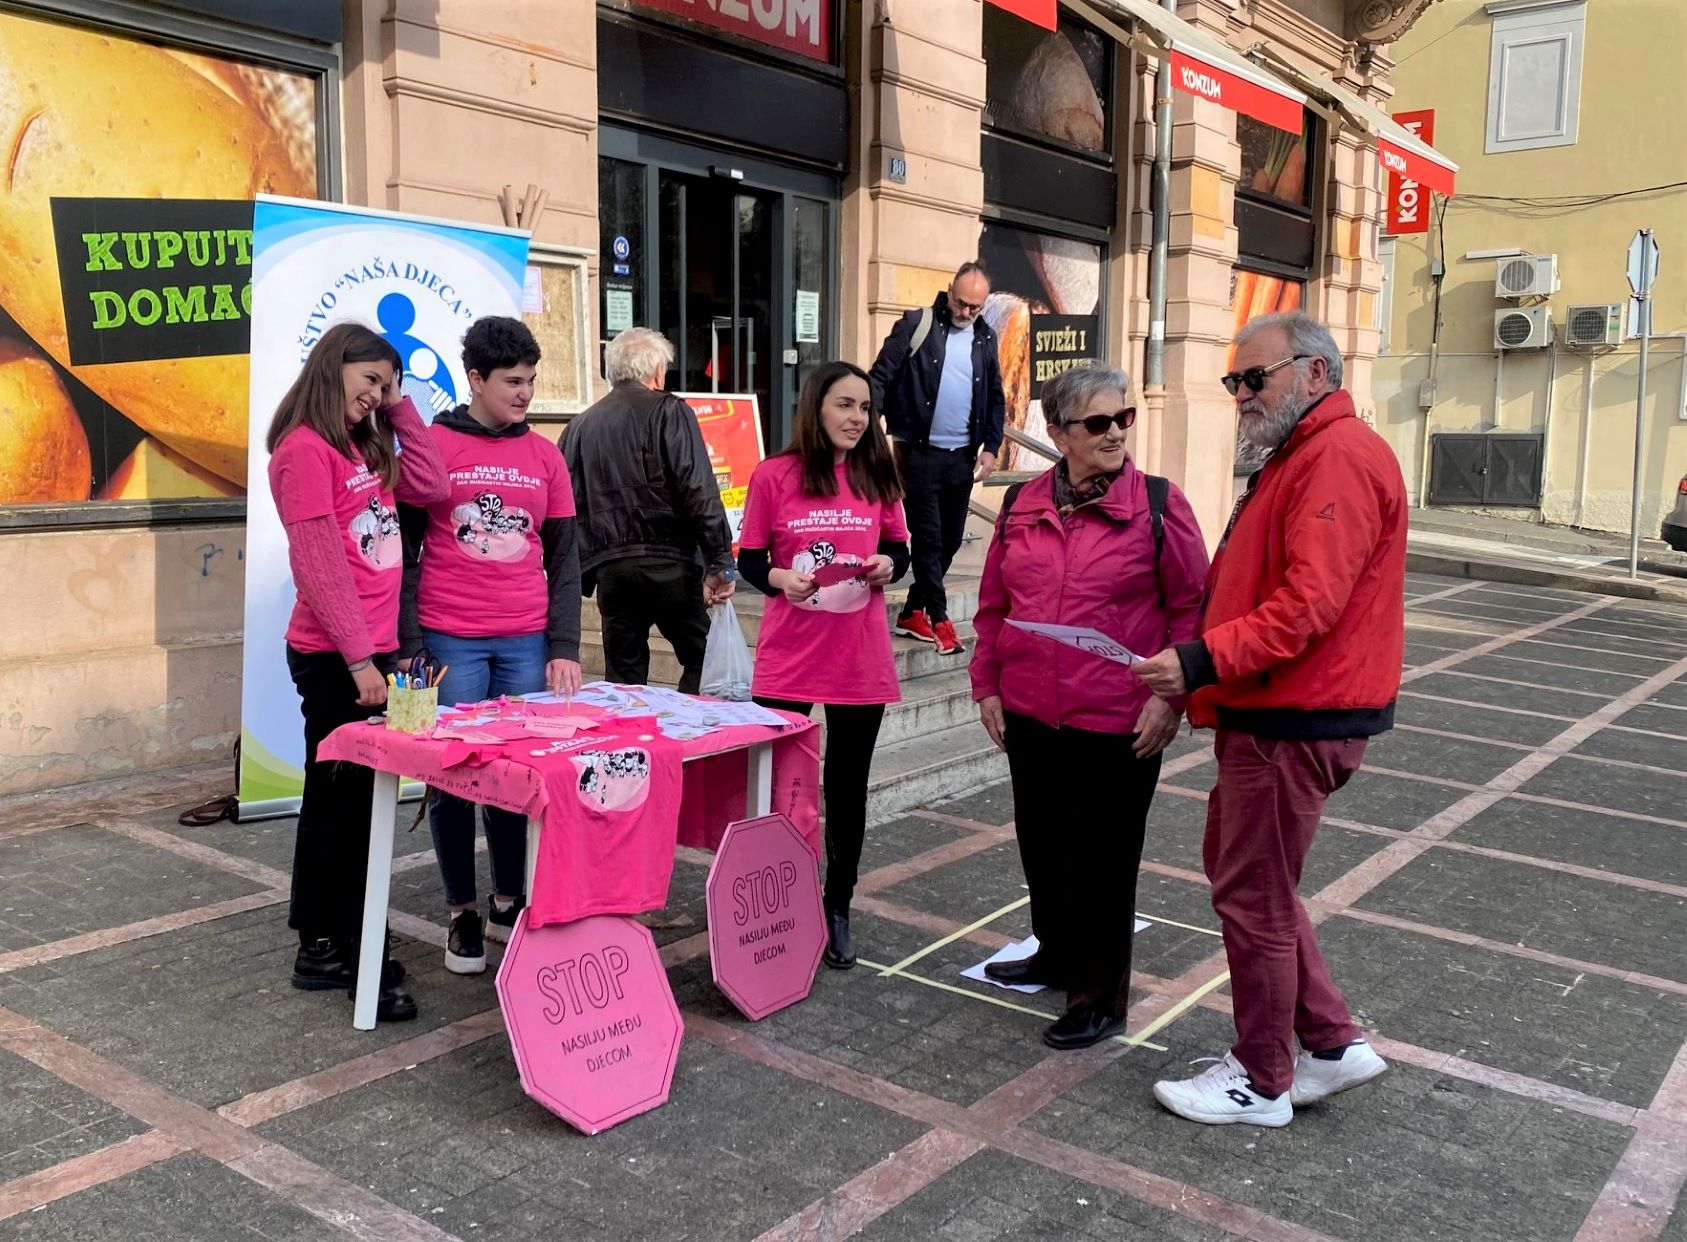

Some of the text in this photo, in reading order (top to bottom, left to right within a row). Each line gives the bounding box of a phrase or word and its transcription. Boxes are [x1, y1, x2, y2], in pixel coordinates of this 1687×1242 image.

[1181, 66, 1222, 100] KONZUM
[893, 158, 905, 176] 80
[1036, 325, 1086, 352] SVJEŽI I
[449, 472, 541, 487] PRESTAJE OVDJE
[474, 466, 519, 475] NASILJE
[787, 517, 873, 529] PRESTAJE OVDJE
[808, 509, 853, 518] NASILJE
[733, 860, 797, 926] STOP
[739, 926, 769, 947] NASILJU
[754, 942, 786, 965] DJECOM
[536, 945, 629, 1026] STOP
[561, 1028, 606, 1056] NASILJU
[586, 1043, 632, 1073] DJECOM
